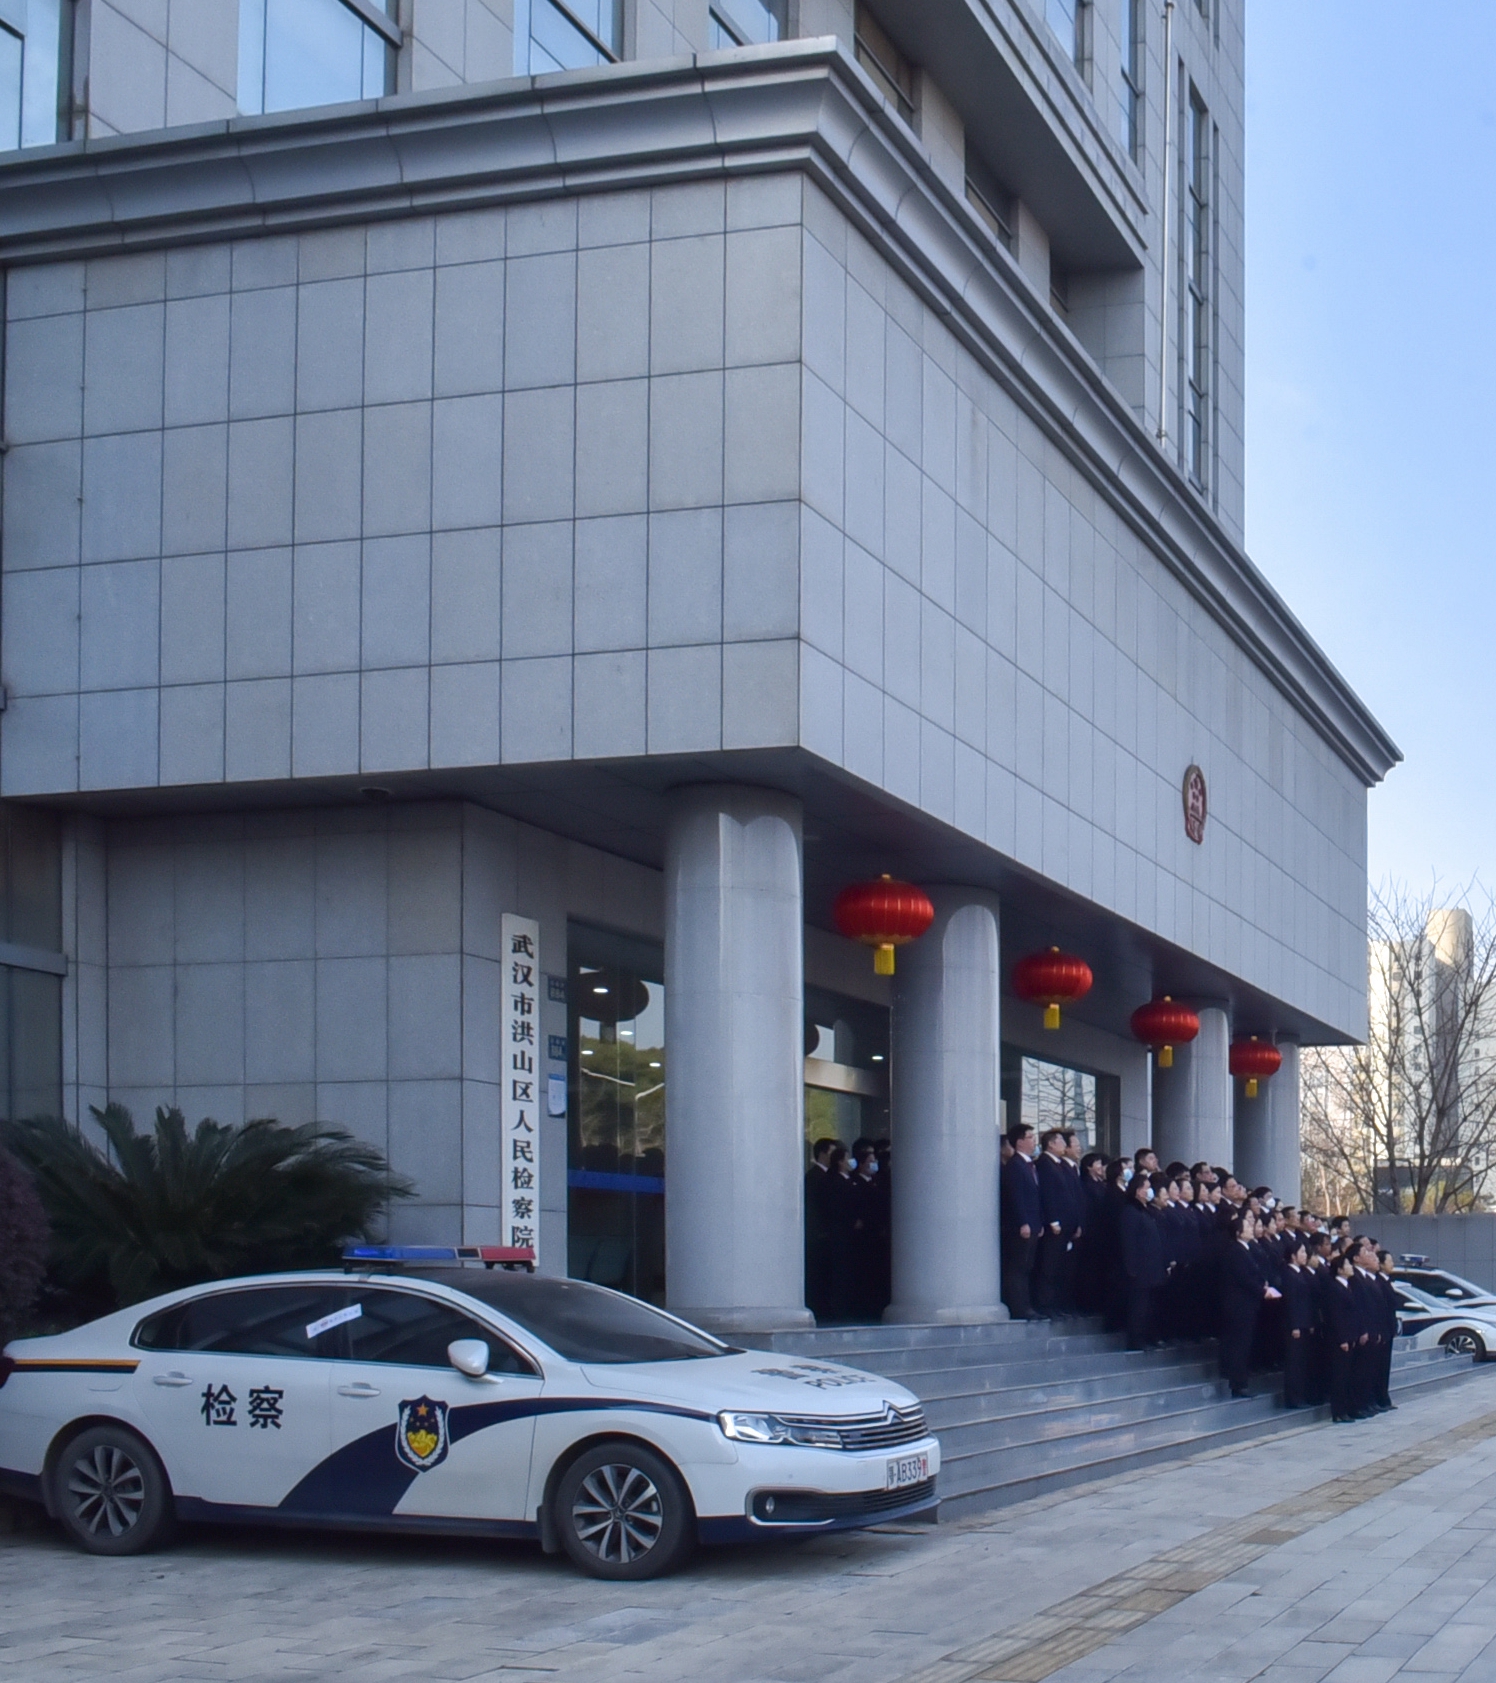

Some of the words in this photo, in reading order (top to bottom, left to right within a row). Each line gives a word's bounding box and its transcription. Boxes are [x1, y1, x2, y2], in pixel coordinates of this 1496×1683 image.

[511, 933, 535, 1247] 武汉市洪山区人民检察院
[201, 1383, 284, 1430] 检察
